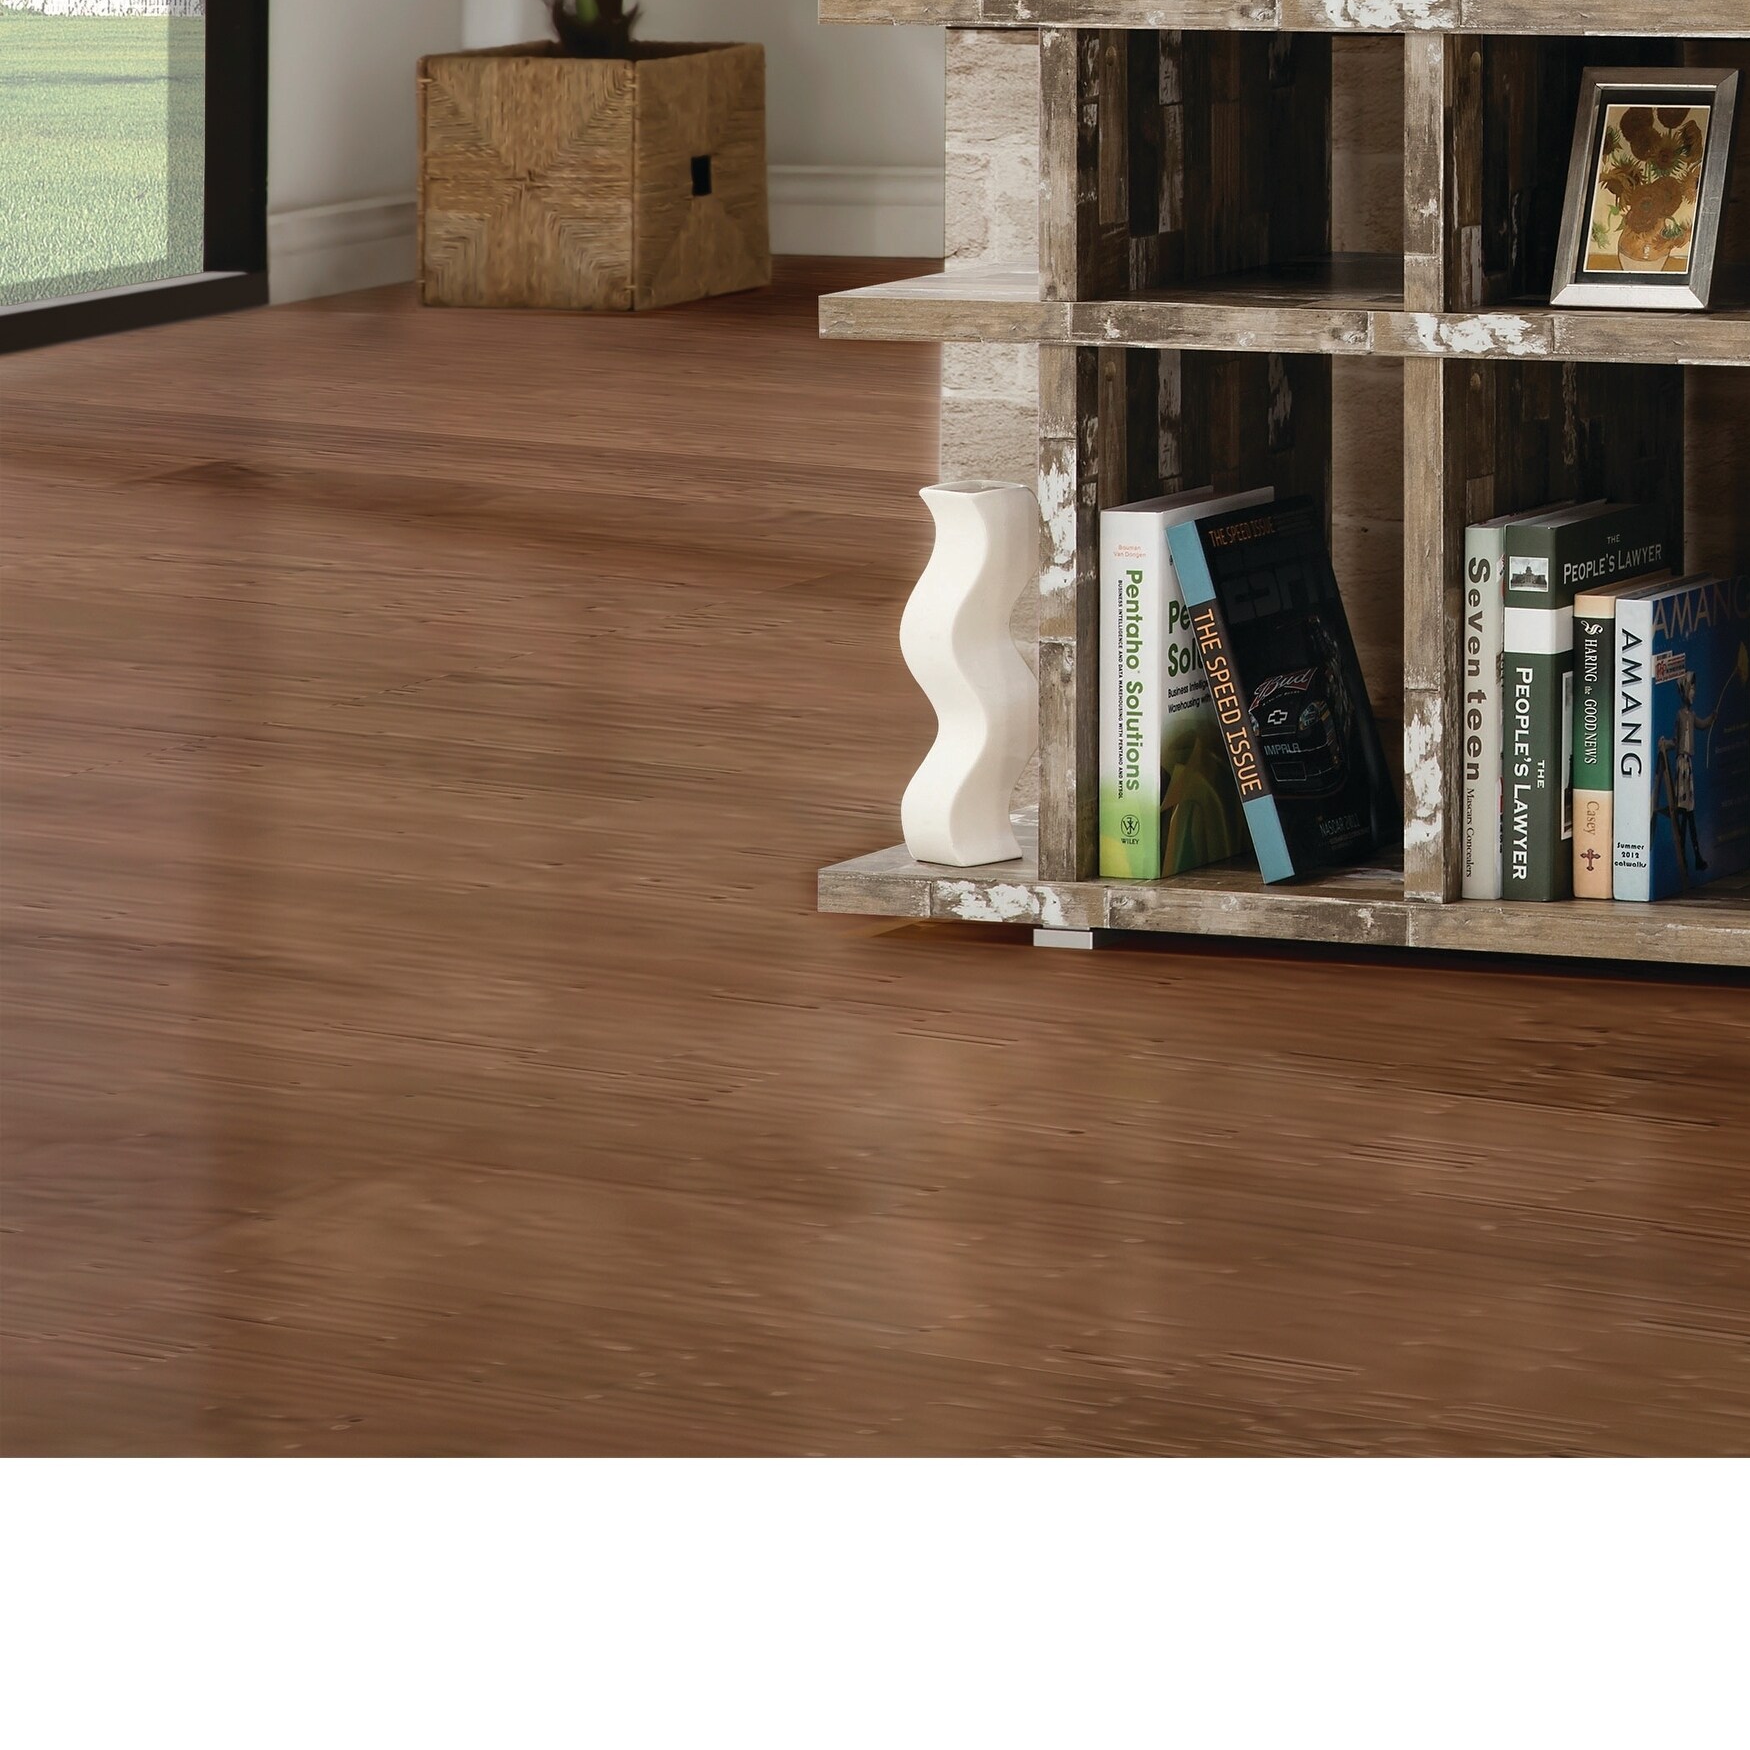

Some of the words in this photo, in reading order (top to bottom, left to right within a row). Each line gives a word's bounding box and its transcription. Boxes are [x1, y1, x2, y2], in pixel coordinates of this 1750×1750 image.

[1208, 529, 1227, 547] THE
[1563, 553, 1615, 585] PEOPLE'S
[1618, 544, 1662, 570] LAWYER
[1607, 534, 1621, 544] THE
[1126, 570, 1143, 669] Pentaho
[1194, 608, 1222, 654] THE
[1467, 557, 1491, 677] Seven
[1652, 576, 1750, 641] AMANG
[1206, 656, 1242, 725] SPEED
[1254, 669, 1312, 700] Bud
[1620, 628, 1643, 778] AMANG
[1126, 681, 1143, 790] Solutions
[1467, 689, 1487, 781] teen
[1513, 667, 1533, 777] PEOPLE'S
[1584, 699, 1597, 730] GOOD
[1226, 727, 1262, 796] ISSUE
[1537, 760, 1545, 788] THE
[1584, 733, 1597, 764] NEWS
[1512, 783, 1532, 880] LAWYER
[1583, 801, 1599, 835] Casey
[1466, 828, 1475, 878] Concealers
